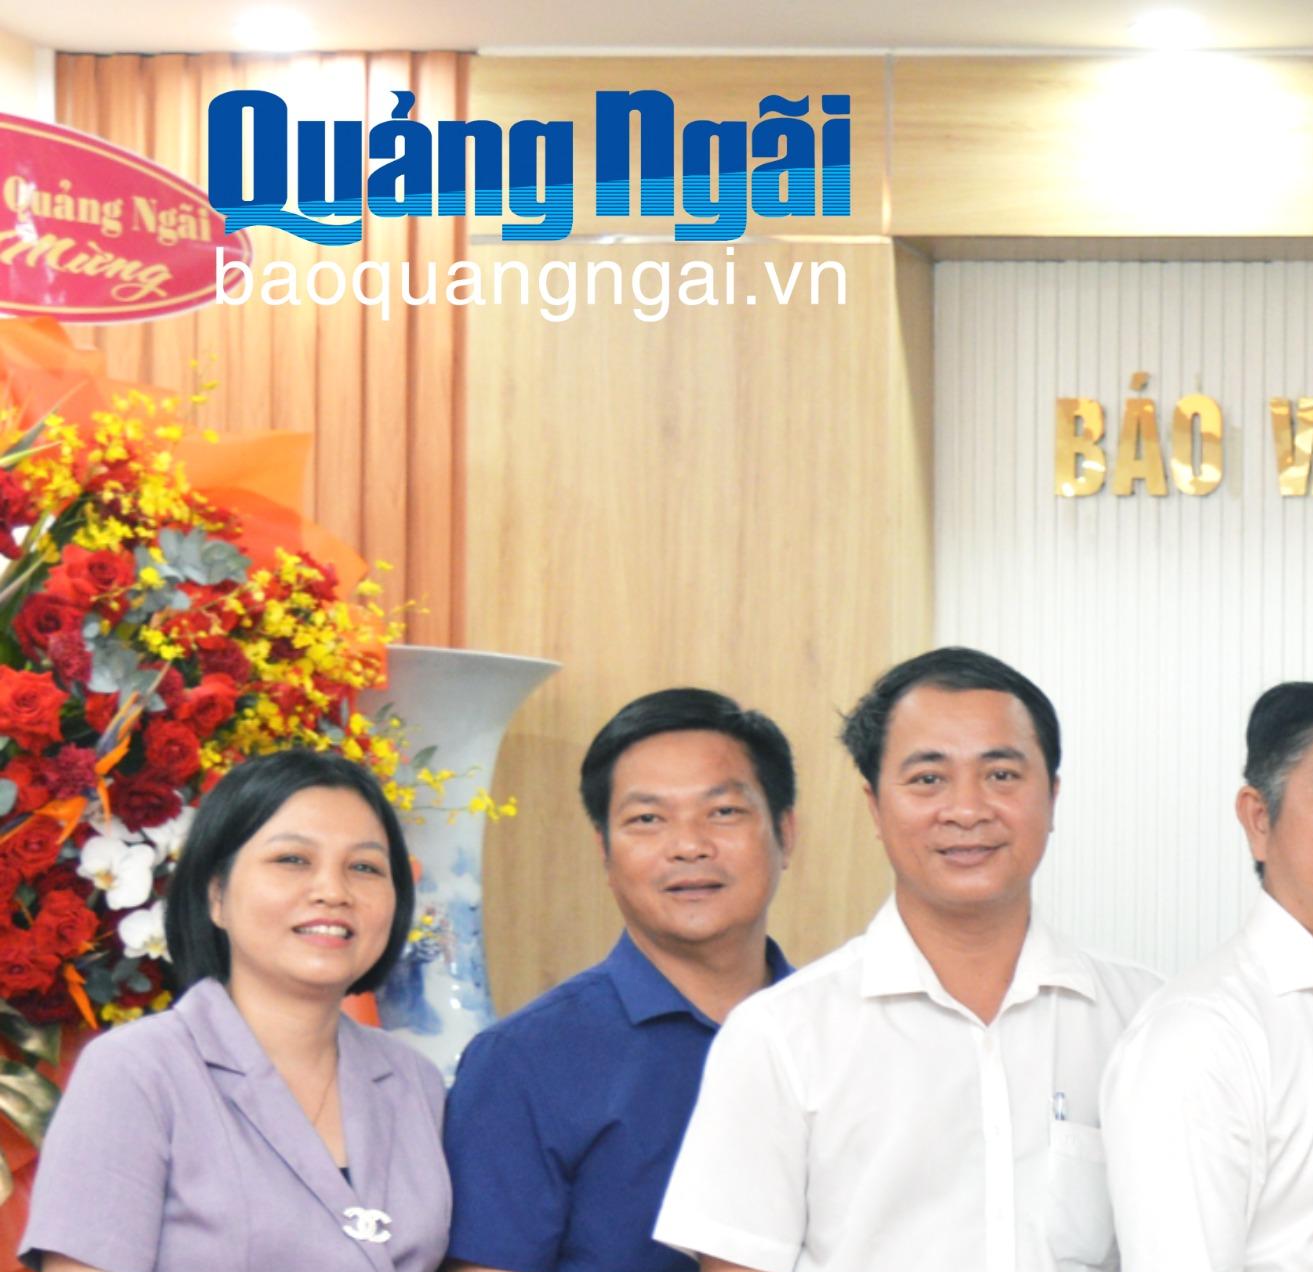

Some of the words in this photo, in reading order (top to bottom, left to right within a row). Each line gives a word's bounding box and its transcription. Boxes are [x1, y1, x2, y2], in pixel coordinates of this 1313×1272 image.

[4, 175, 123, 238] Quảng
[132, 196, 212, 246] Ngãi
[0, 229, 172, 302] Mừng
